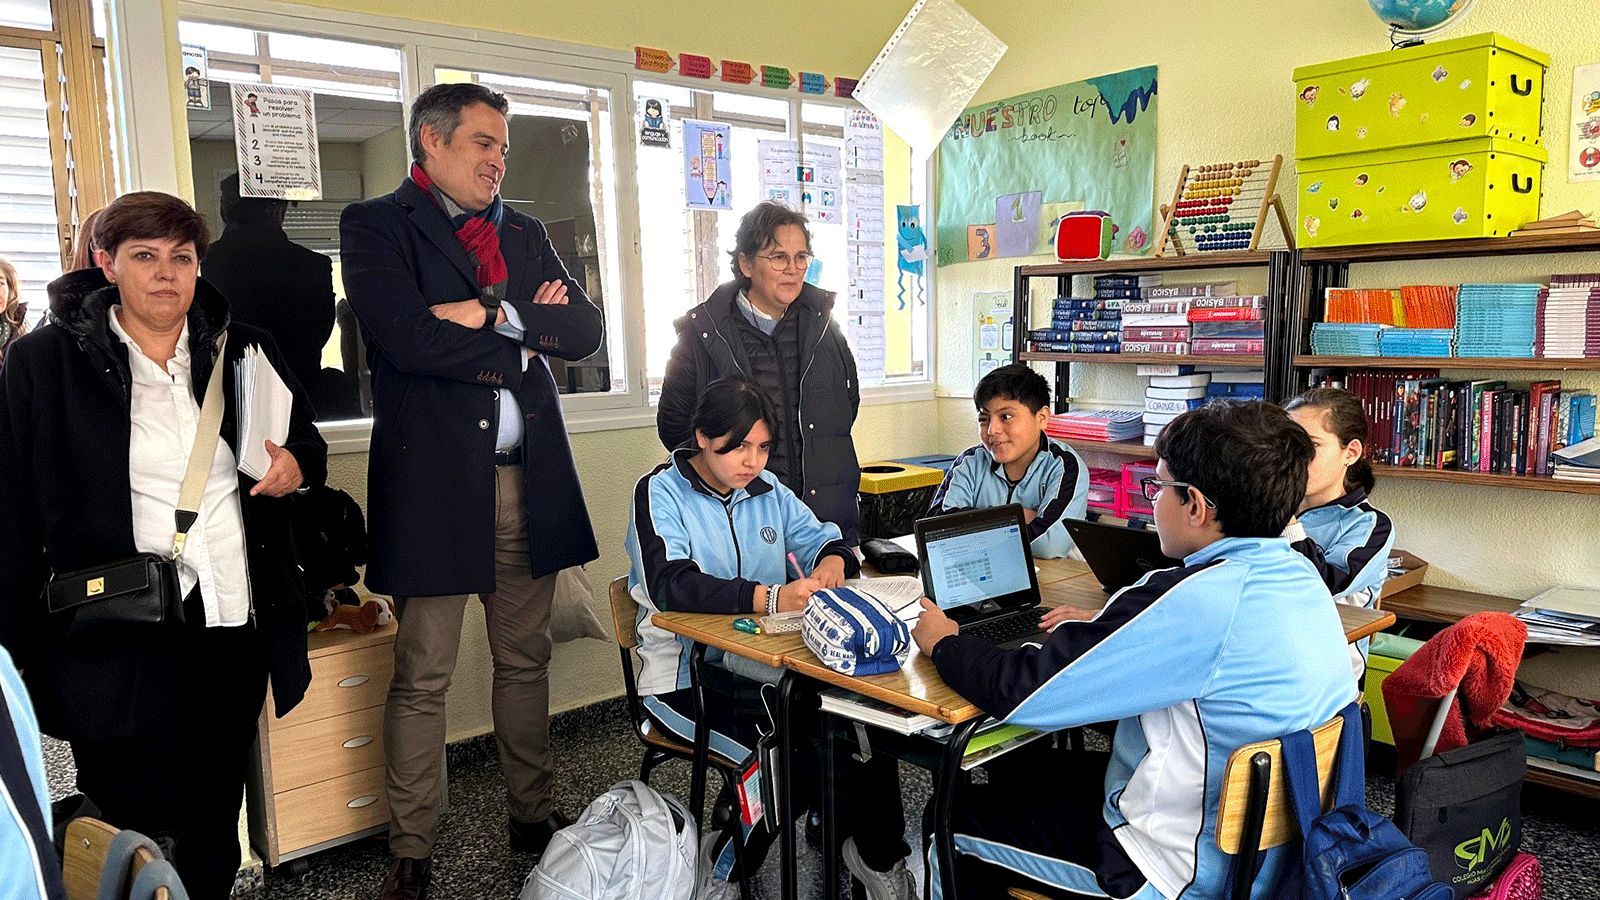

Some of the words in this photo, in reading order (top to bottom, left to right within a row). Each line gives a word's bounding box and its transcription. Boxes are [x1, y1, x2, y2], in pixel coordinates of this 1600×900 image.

[263, 97, 282, 105] Pasos
[953, 94, 1058, 140] NUESTRO
[1073, 95, 1109, 118] top
[252, 123, 256, 134] 1
[252, 139, 260, 150] 2
[254, 155, 261, 166] 3
[255, 173, 263, 184] 4
[1011, 198, 1026, 224] 1
[975, 228, 991, 258] 3
[1152, 288, 1179, 297] BÁSICO
[1126, 304, 1152, 313] BÁSICO
[1196, 299, 1224, 308] BÁSICO
[1124, 344, 1150, 353] BÁSICO
